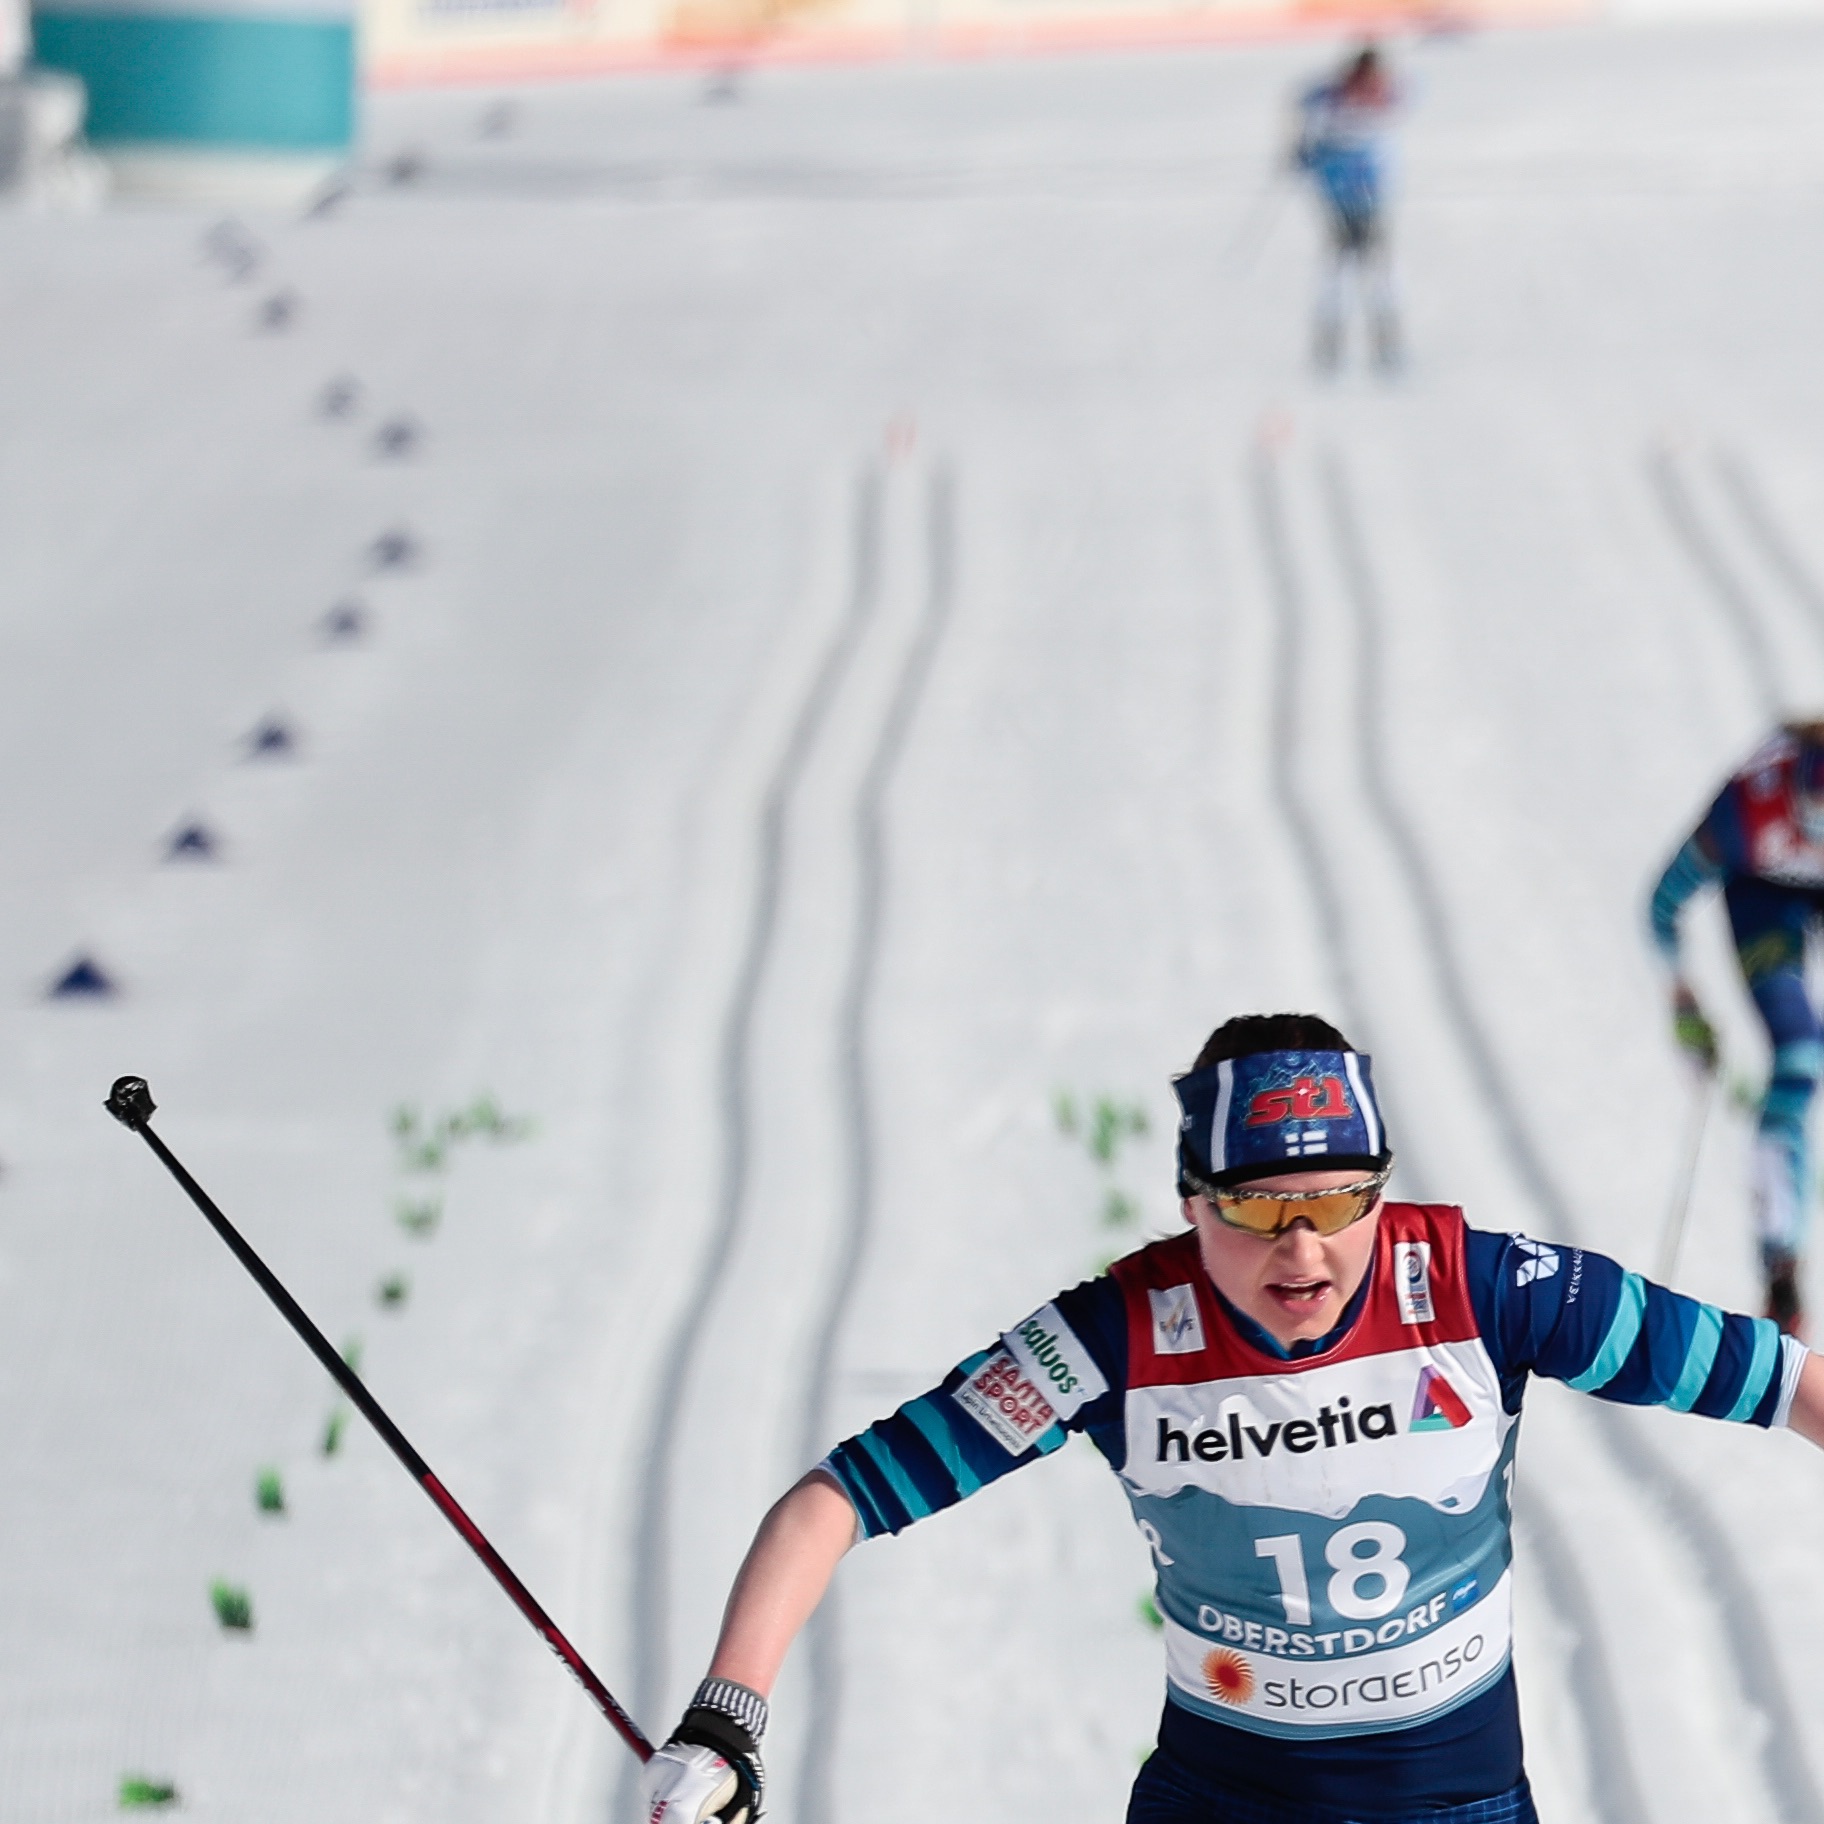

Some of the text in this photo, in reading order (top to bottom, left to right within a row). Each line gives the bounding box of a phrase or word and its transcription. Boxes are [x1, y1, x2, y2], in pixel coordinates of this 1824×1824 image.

[1246, 1077, 1353, 1127] st1
[992, 1355, 1054, 1423] SANTA
[1019, 1319, 1078, 1394] salvos
[974, 1371, 1042, 1434] SPORT
[1156, 1395, 1398, 1463] helvetia
[1254, 1520, 1411, 1627] 18
[1198, 1592, 1447, 1656] OBERSTDORF
[1264, 1634, 1485, 1709] storaenso
